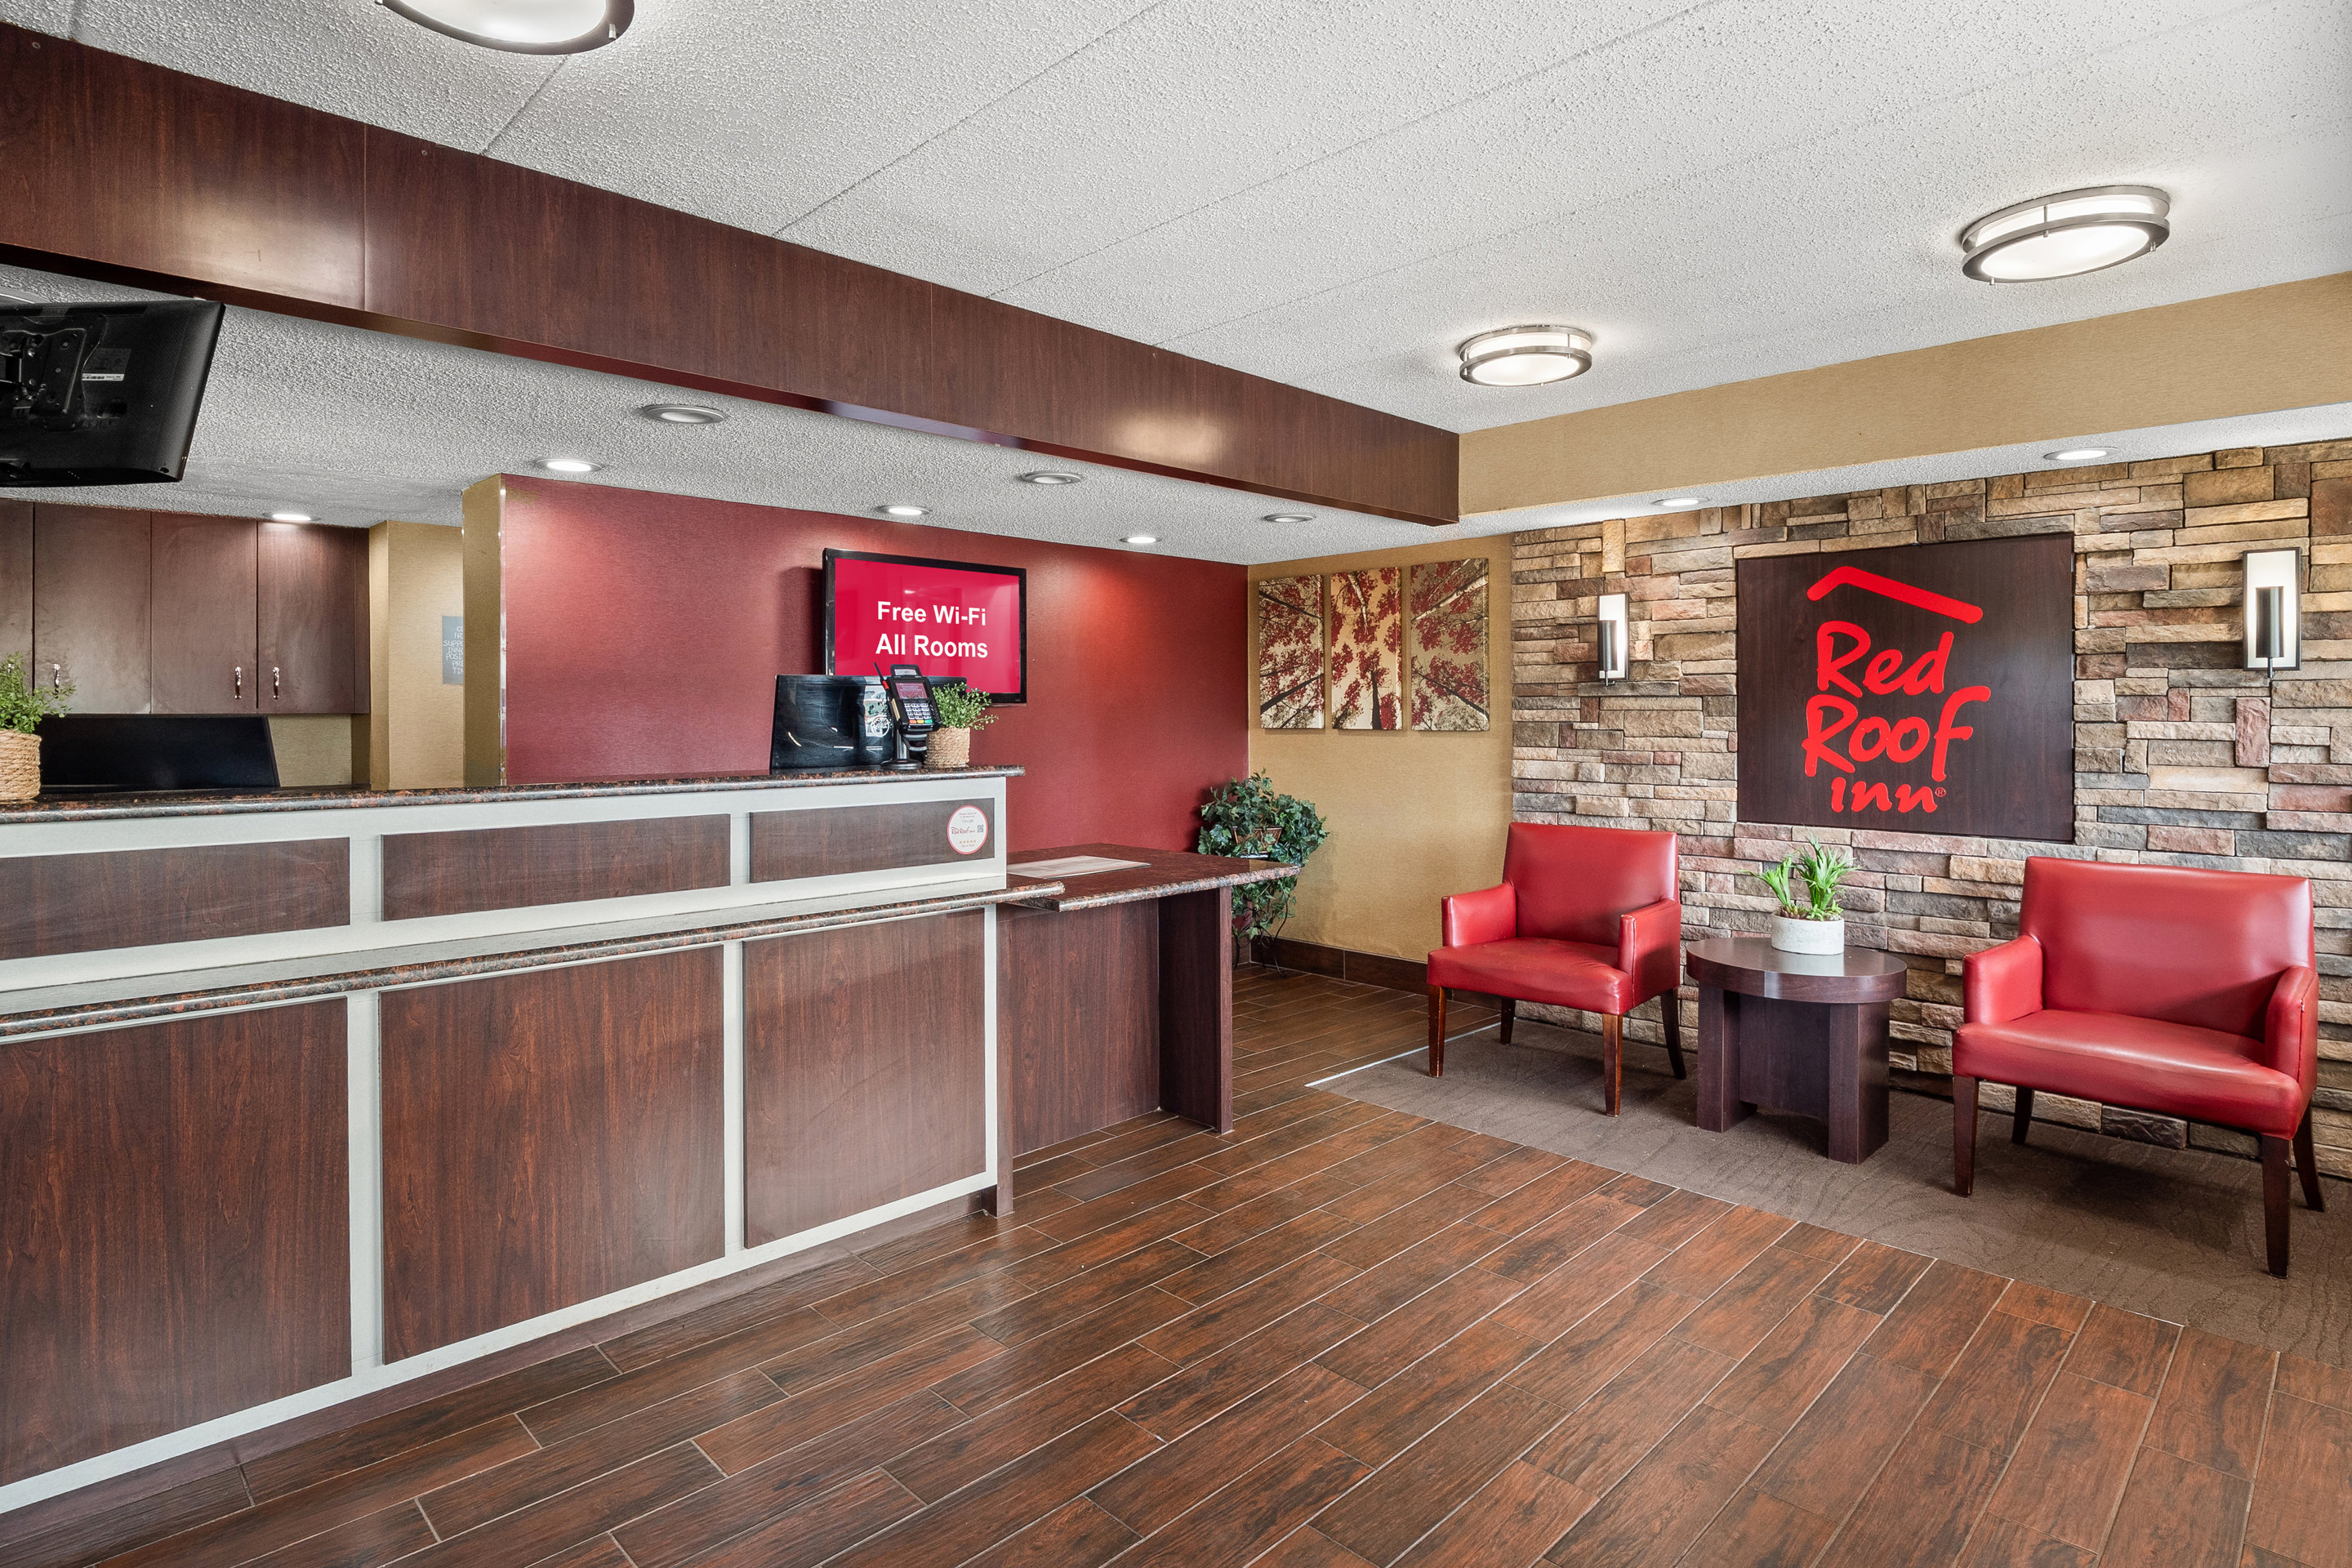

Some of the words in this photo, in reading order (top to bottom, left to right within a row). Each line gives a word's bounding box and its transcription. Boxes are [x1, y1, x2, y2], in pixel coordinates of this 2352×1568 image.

[876, 600, 927, 623] Free
[933, 604, 987, 626] Wi-Fi
[875, 633, 906, 656] All
[914, 635, 988, 658] Rooms
[1816, 620, 1954, 698] Red
[1802, 685, 1991, 782] Roof
